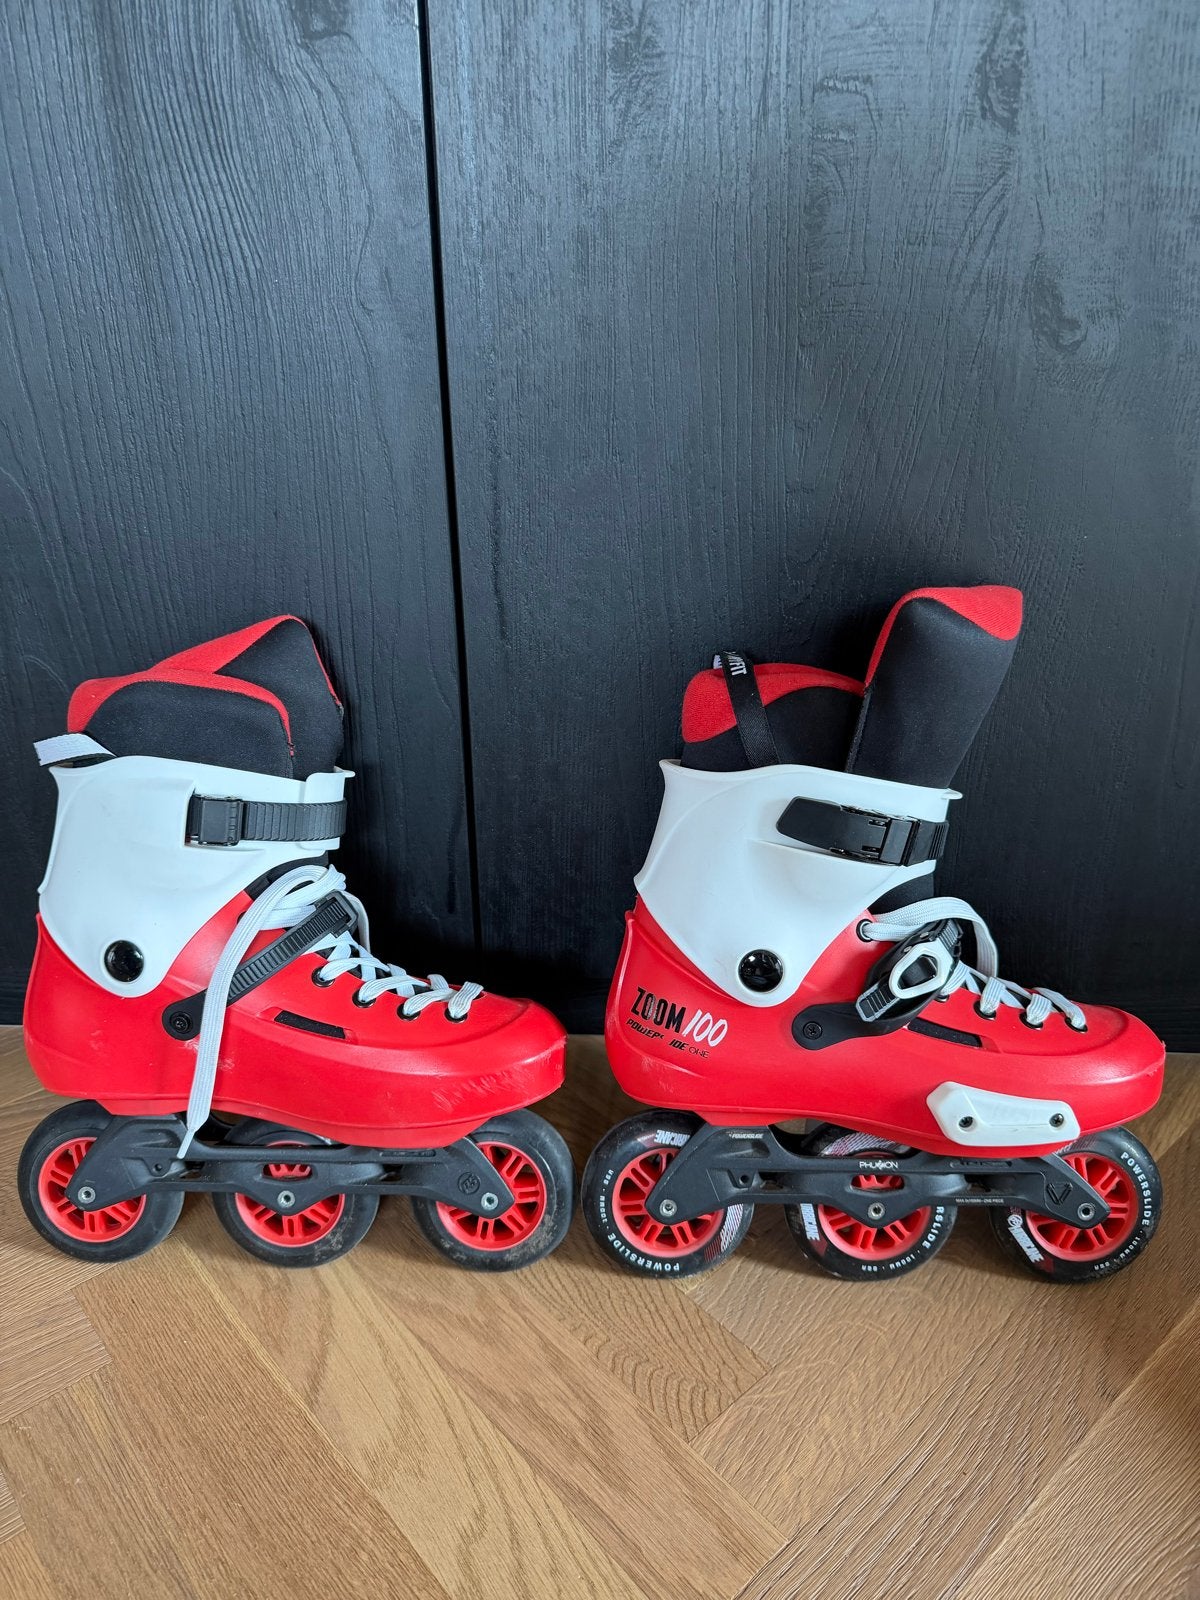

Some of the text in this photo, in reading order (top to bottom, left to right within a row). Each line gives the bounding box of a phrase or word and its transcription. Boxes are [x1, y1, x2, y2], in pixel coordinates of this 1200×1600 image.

[630, 986, 729, 1048] ZOOM 100
[1120, 1150, 1153, 1227] POWERSLIDE
[607, 1232, 681, 1272] POWERSLIDE
[921, 1205, 945, 1250] RSLIDE
